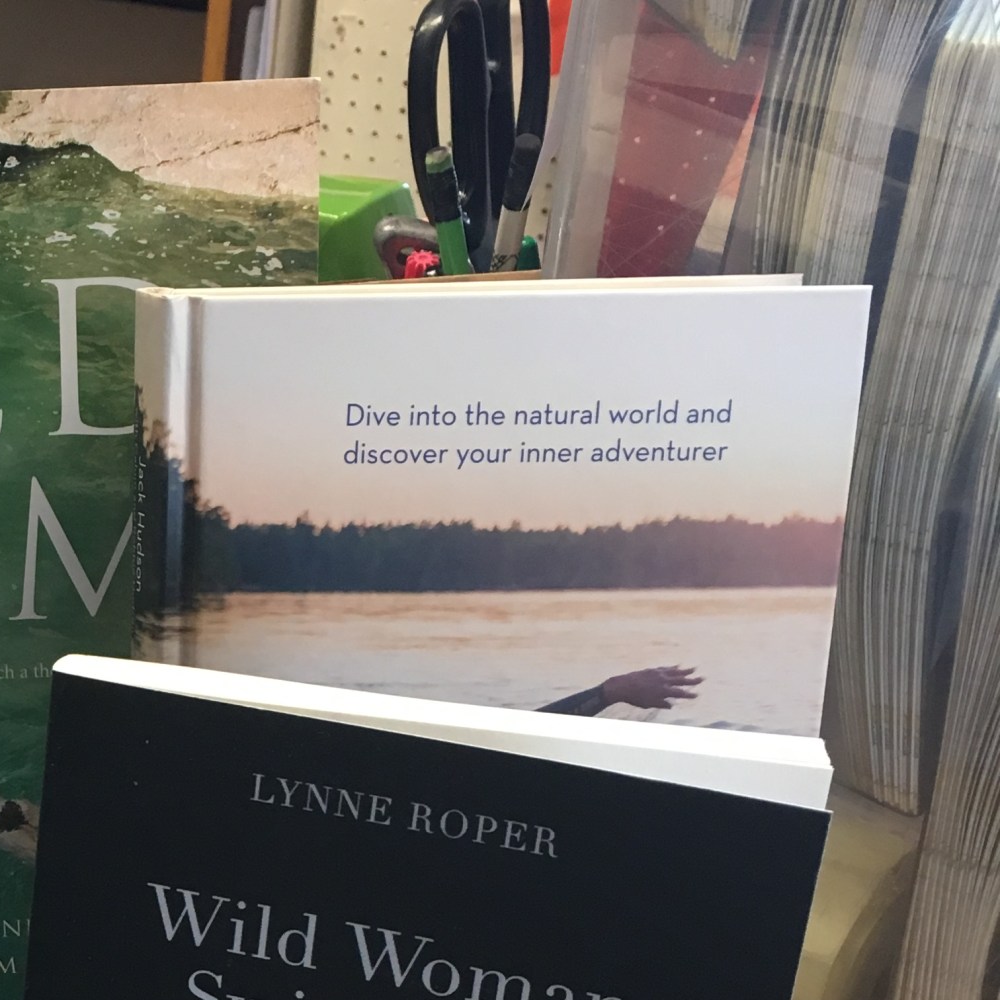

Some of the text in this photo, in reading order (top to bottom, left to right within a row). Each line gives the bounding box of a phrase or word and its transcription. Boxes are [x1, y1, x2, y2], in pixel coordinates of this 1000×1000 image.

[346, 399, 732, 427] Dive into the natural world and
[343, 438, 728, 470] discover your inner adventurer
[137, 456, 147, 504] Jack
[135, 513, 146, 593] Hudson
[19, 668, 28, 679] a
[33, 662, 53, 679] th
[250, 773, 559, 858] LYNNE ROPER
[147, 882, 319, 970] Wild
